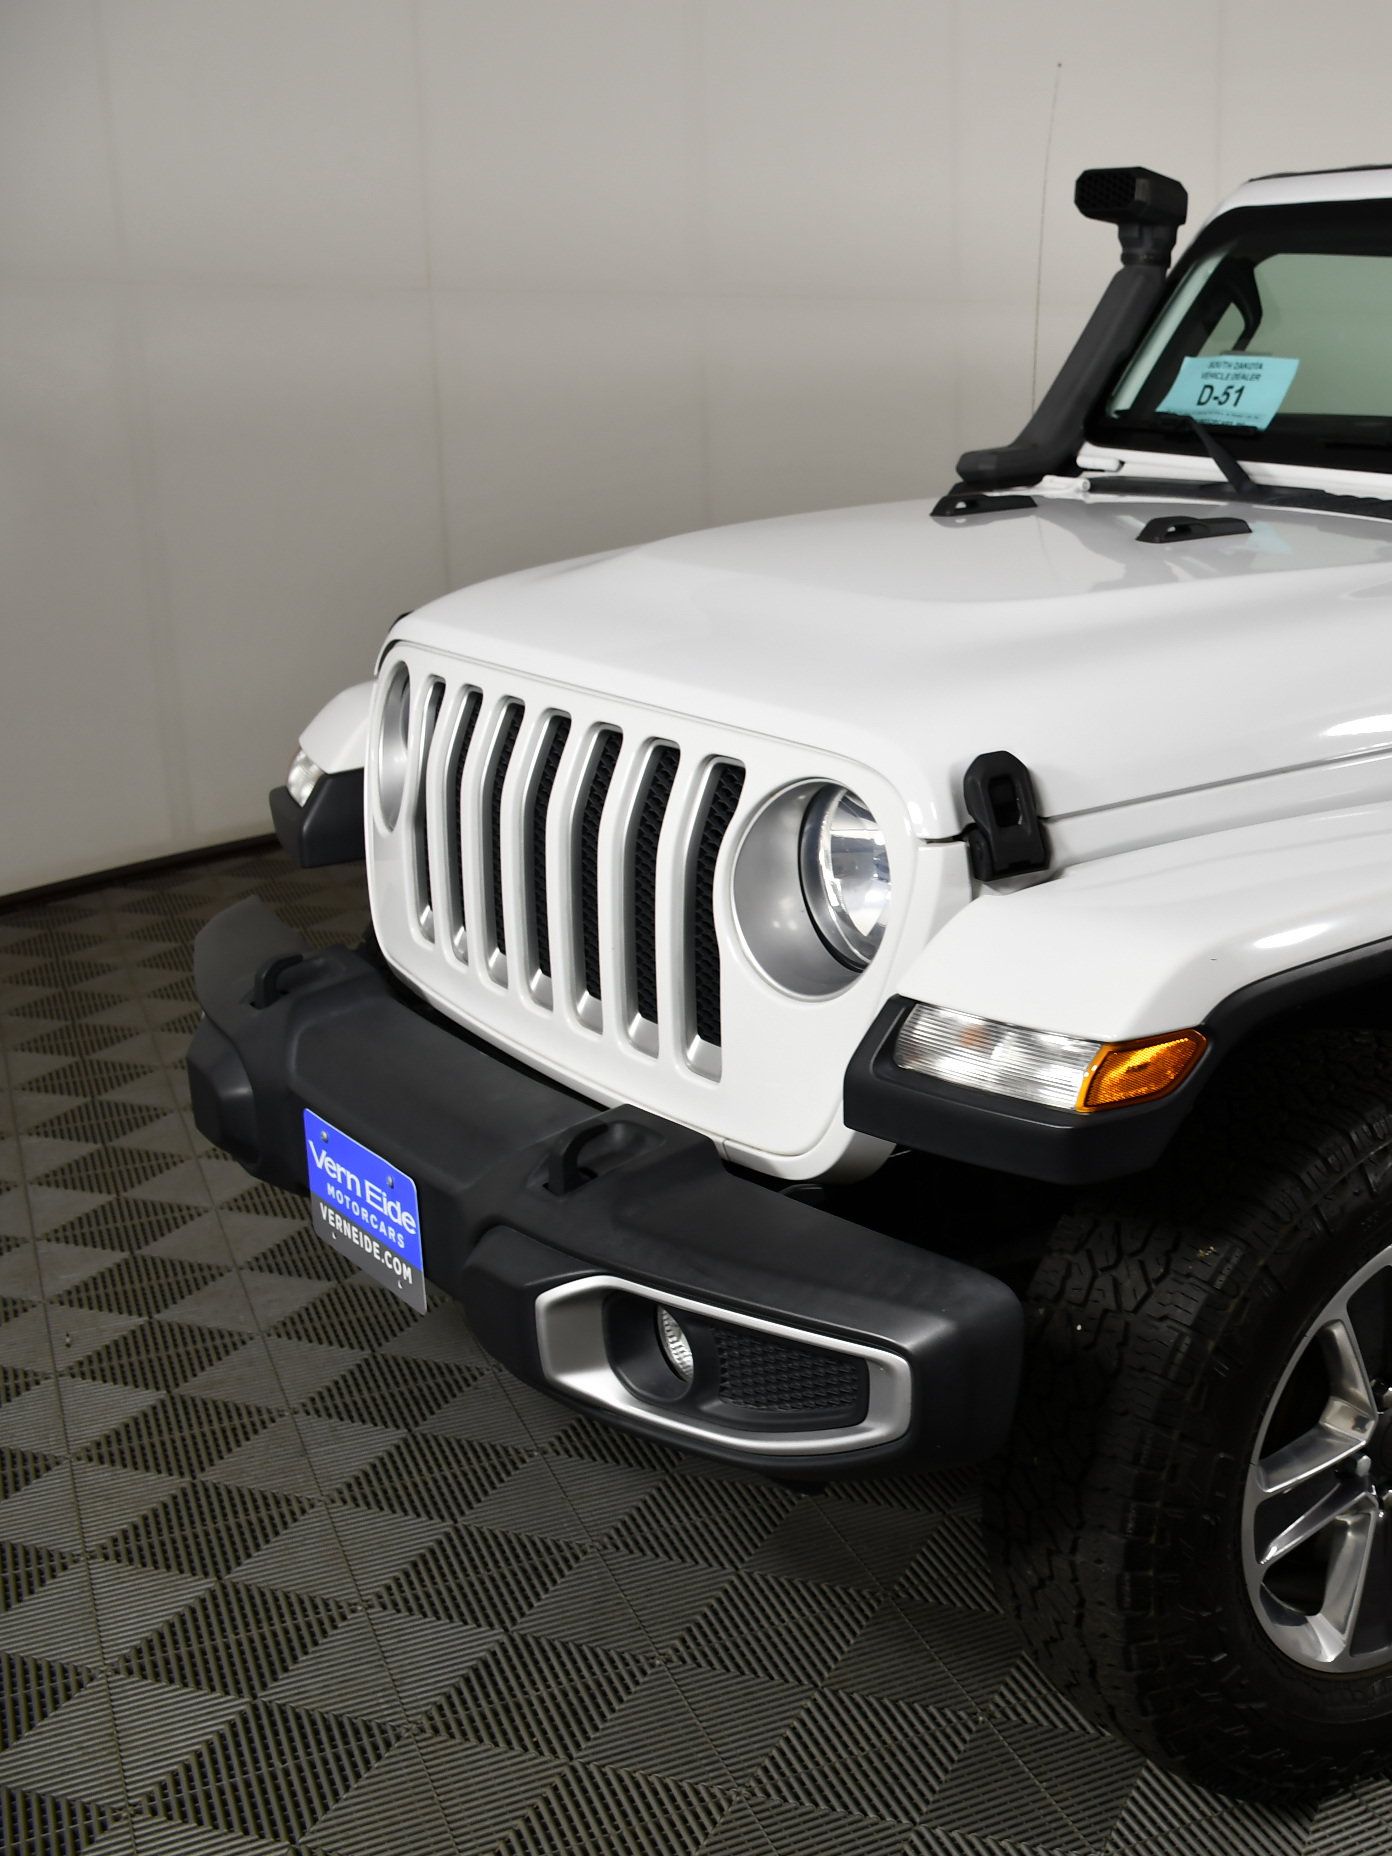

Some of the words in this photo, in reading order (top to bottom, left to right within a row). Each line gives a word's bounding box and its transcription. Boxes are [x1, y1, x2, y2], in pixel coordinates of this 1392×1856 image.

[1201, 372, 1230, 381] VEHICLE
[1231, 373, 1261, 382] DEALER
[1208, 361, 1232, 370] SOUTH
[1233, 361, 1263, 370] DAKOTA
[1196, 384, 1245, 407] D-51
[308, 1139, 362, 1198] Vern
[364, 1178, 417, 1235] Eide
[326, 1183, 405, 1249] MOTORCARS
[319, 1202, 413, 1285] VERNEIDE.COM
